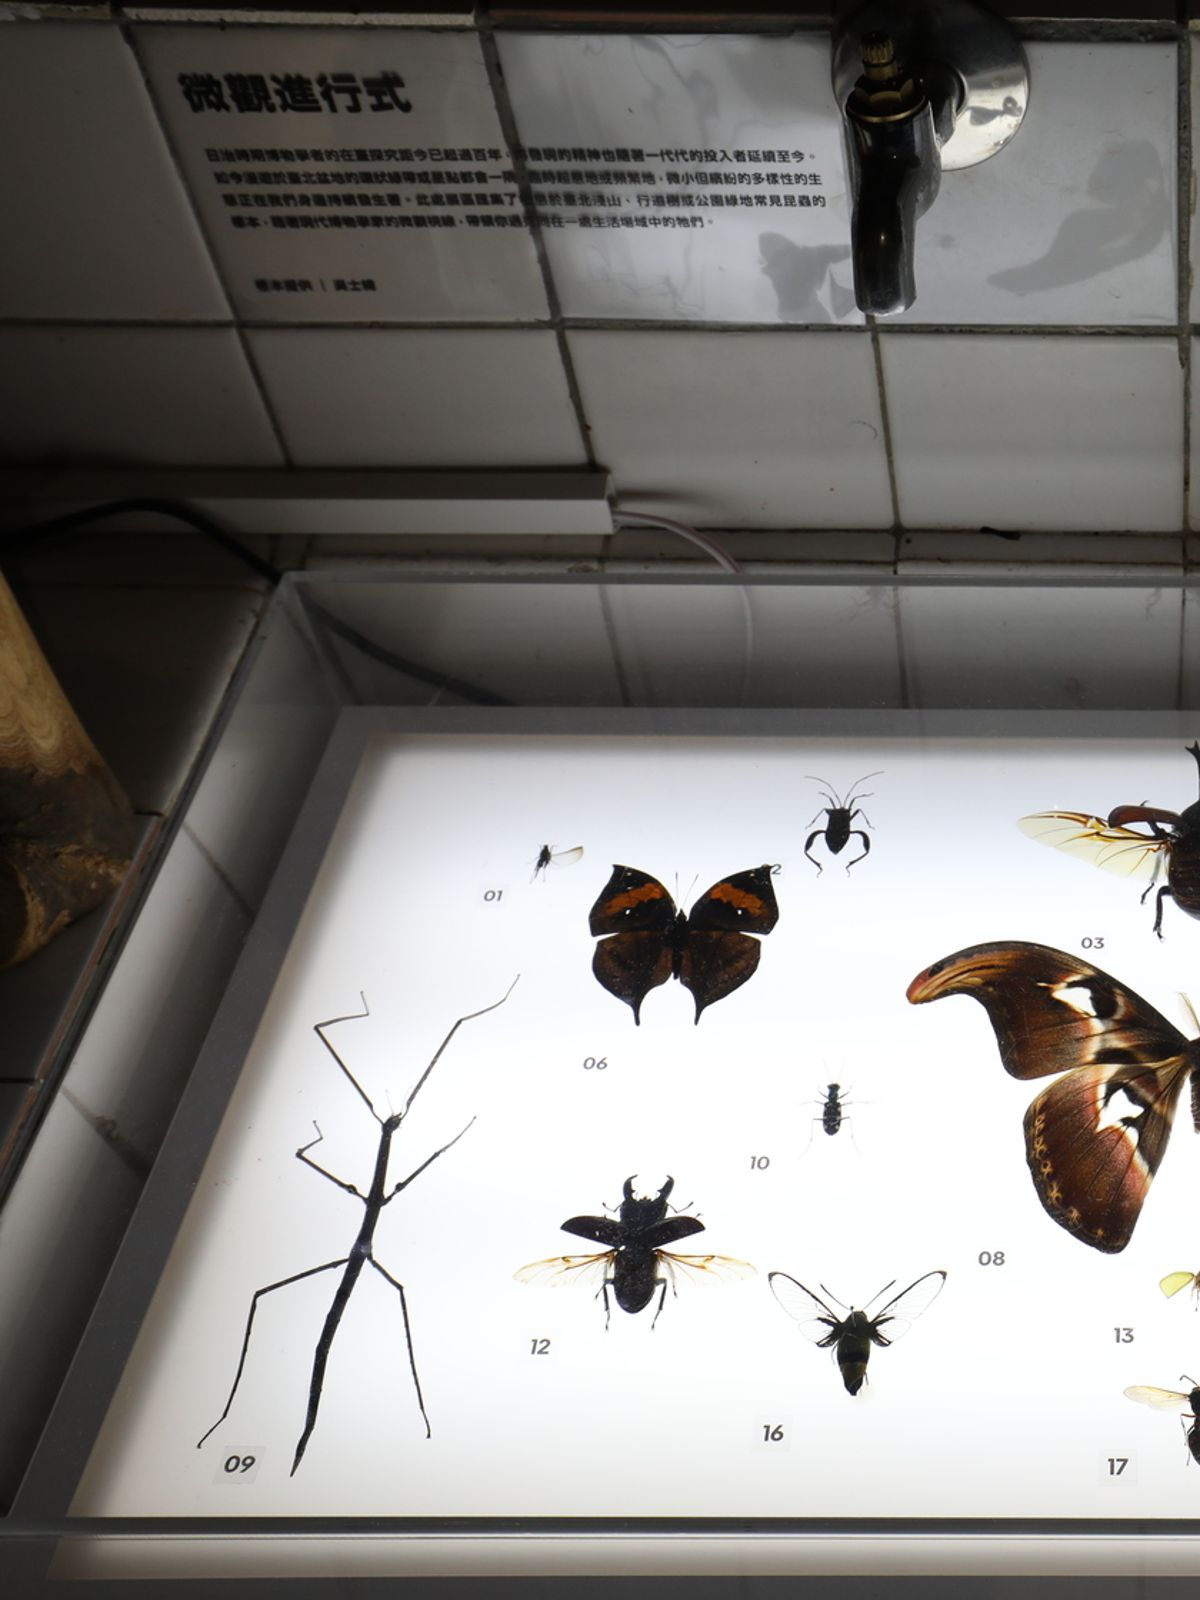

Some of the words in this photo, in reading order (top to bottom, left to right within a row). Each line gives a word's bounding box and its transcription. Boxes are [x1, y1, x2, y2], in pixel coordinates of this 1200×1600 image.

[178, 71, 412, 114] 微觀進行式
[483, 890, 503, 902] 01
[1081, 937, 1105, 949] 03
[583, 1056, 608, 1071] 06
[750, 1156, 770, 1171] 10
[978, 1250, 1006, 1267] 08
[1114, 1327, 1135, 1344] 13
[530, 1338, 551, 1354] 12
[763, 1424, 784, 1441] 16
[223, 1455, 256, 1473] 09
[1107, 1458, 1129, 1475] 17
